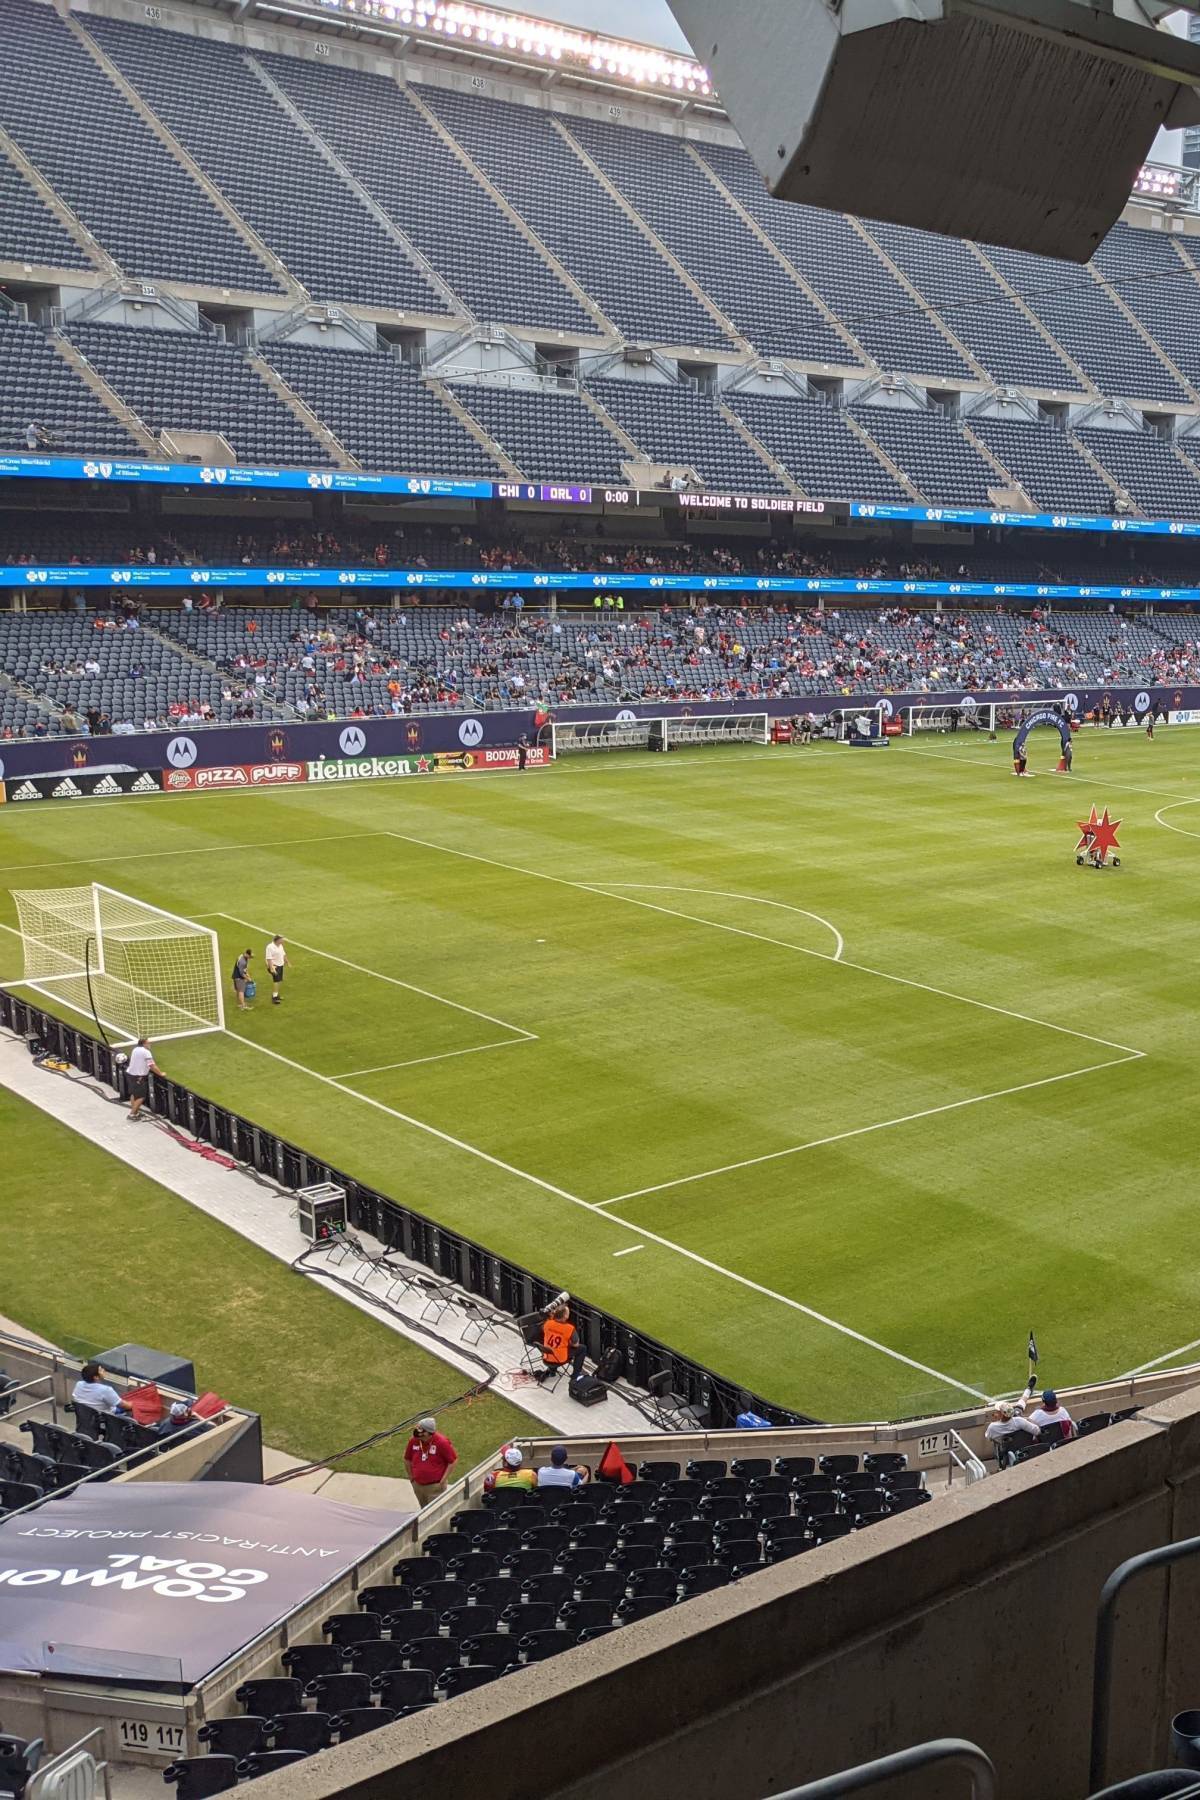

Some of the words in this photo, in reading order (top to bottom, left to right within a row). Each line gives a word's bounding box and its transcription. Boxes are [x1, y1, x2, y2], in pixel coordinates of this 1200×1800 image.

[145, 6, 160, 19] 436
[315, 43, 329, 54] 437
[472, 77, 484, 88] 438
[609, 106, 621, 117] 439
[143, 286, 154, 295] 334
[498, 484, 520, 498] CHI
[527, 486, 535, 498] 0
[550, 487, 573, 500] ORL
[579, 489, 587, 501] 0
[605, 490, 629, 503] 0:00
[679, 494, 732, 508] WELCOME
[735, 497, 749, 509] TO
[751, 498, 794, 511] SOLDIER
[796, 500, 825, 512] FIELD
[1025, 713, 1046, 729] CHICAGO
[1047, 713, 1058, 722] FIRE
[197, 767, 247, 786] PIZZA
[251, 763, 300, 782] PUFF
[307, 757, 411, 781] Heineken
[52, 789, 82, 798] adidas
[93, 785, 123, 794] adidas
[131, 783, 160, 792] adidas
[12, 792, 43, 801] adidas
[548, 1334, 562, 1348] 49
[920, 1436, 938, 1451] 117
[17, 1526, 153, 1539] PROJECT
[154, 1530, 340, 1558] ANTI-RACIST
[107, 1553, 269, 1585] GOAL
[120, 1720, 148, 1743] 119
[156, 1725, 184, 1747] 117
